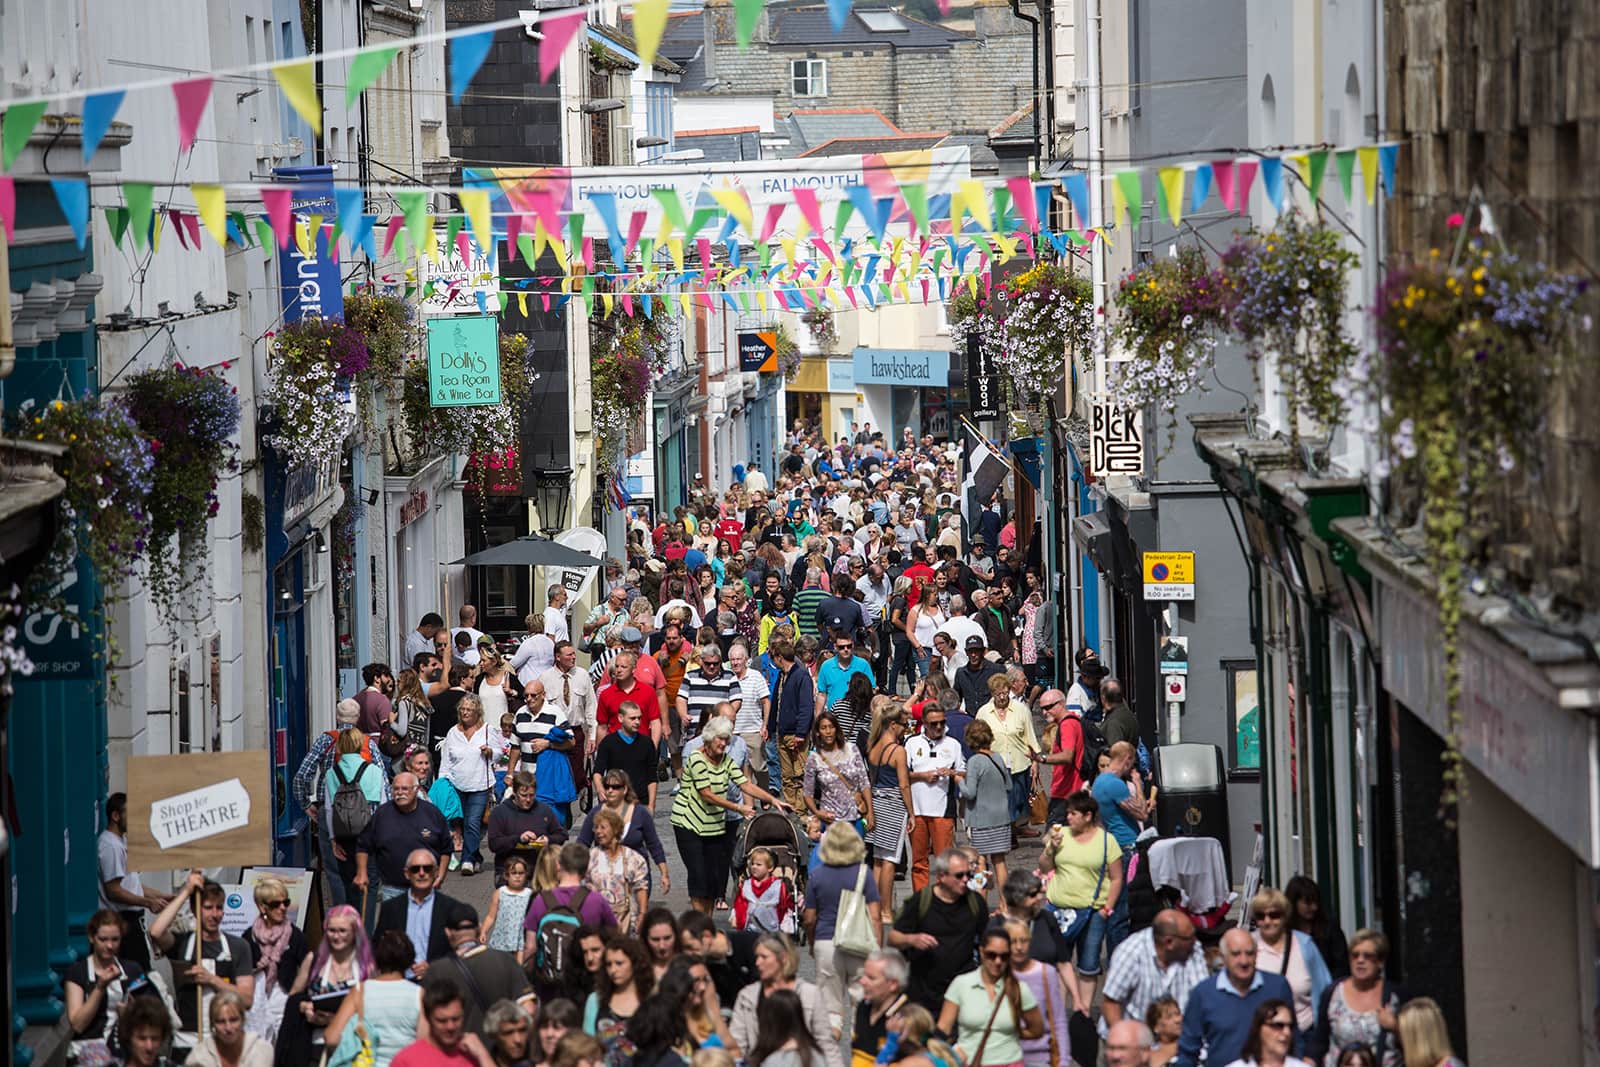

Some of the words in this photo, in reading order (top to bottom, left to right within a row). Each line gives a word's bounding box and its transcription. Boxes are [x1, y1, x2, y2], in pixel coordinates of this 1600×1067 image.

[762, 173, 860, 193] FALMOUTH
[741, 344, 767, 352] Heather
[441, 351, 487, 373] Dolly's
[871, 355, 930, 380] hawkshead
[440, 375, 459, 386] Tea
[462, 374, 490, 387] Room
[437, 389, 446, 401] &
[449, 388, 471, 400] Wine
[475, 387, 494, 399] Bar
[973, 408, 997, 418] gallery
[1093, 435, 1142, 473] DOG
[52, 661, 81, 673] SHOP
[159, 800, 193, 820] Shop
[162, 801, 241, 838] THEATRE
